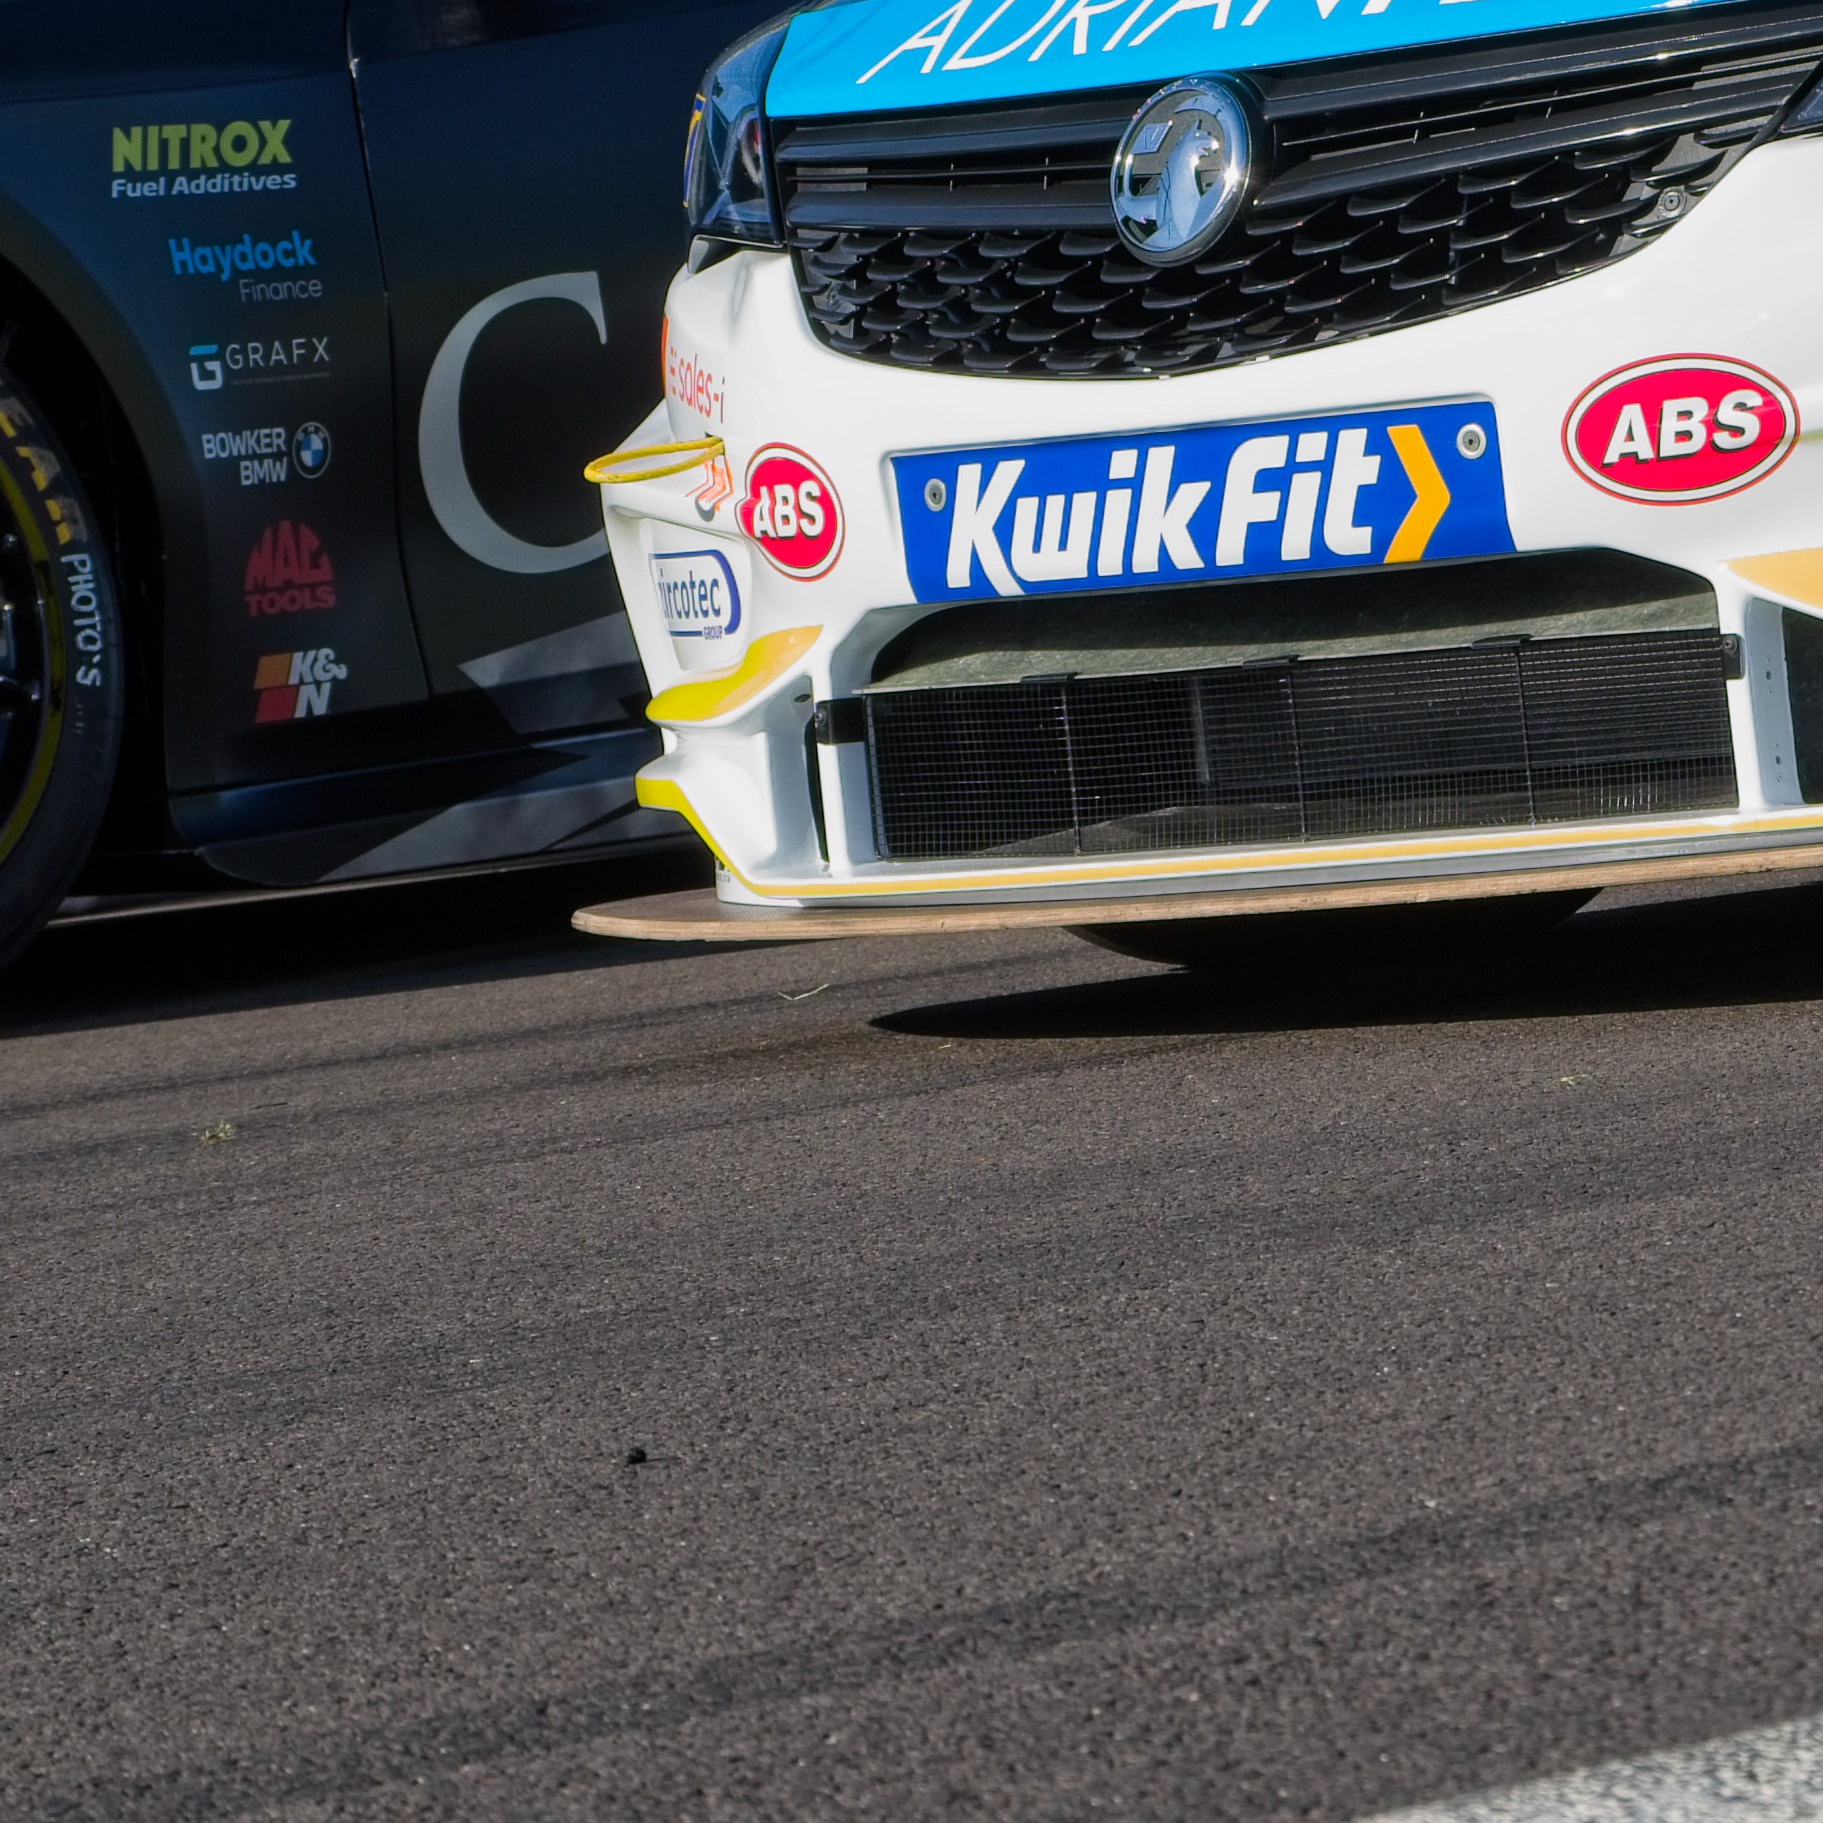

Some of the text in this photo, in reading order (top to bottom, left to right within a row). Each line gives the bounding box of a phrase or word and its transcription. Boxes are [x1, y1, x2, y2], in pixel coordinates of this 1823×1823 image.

[112, 118, 293, 173] NITROX
[111, 172, 297, 198] Fuel Additives
[168, 230, 317, 282] Haydock
[239, 278, 323, 303] Finance
[226, 337, 330, 371] GRAFX
[678, 352, 726, 425] sales-i
[202, 427, 288, 460] BOWKER
[1603, 389, 1764, 469] ABS
[239, 456, 289, 486] BMW
[752, 480, 826, 541] ABS
[244, 519, 334, 591] MAC
[60, 553, 104, 688] PHOTO'S
[244, 584, 336, 617] TOOLS
[293, 681, 332, 719] N
